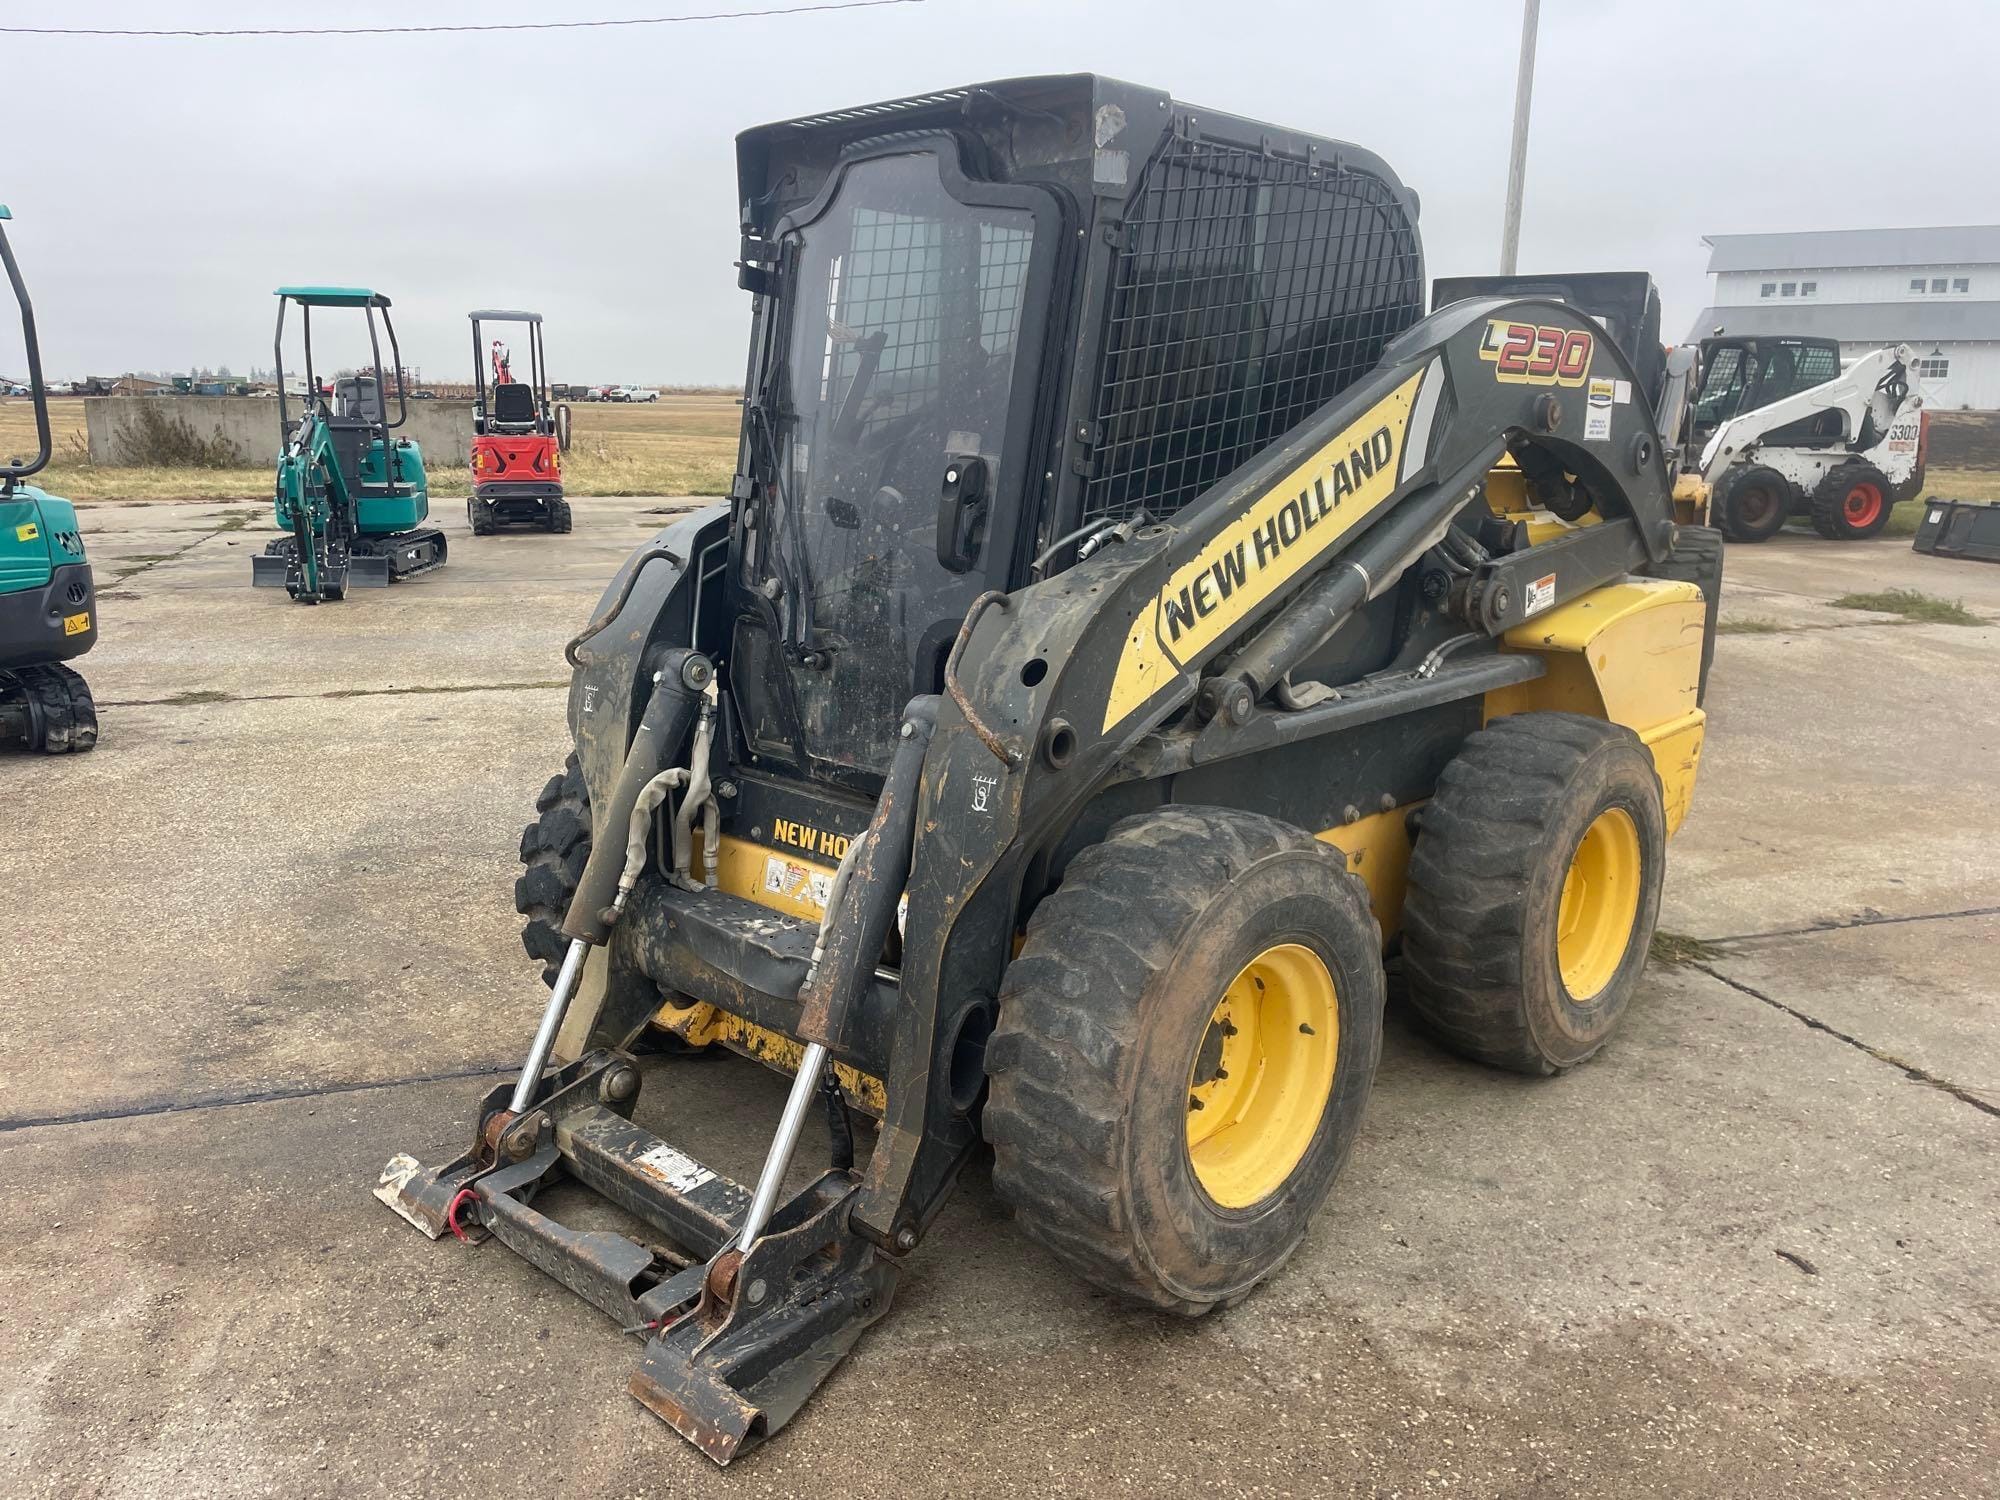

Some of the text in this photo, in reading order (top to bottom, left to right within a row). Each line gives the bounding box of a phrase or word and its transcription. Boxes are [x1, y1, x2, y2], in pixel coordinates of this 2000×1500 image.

[1480, 320, 1593, 386] L230
[1164, 424, 1393, 644] NEW HOLLAND
[774, 818, 818, 851] NEW
